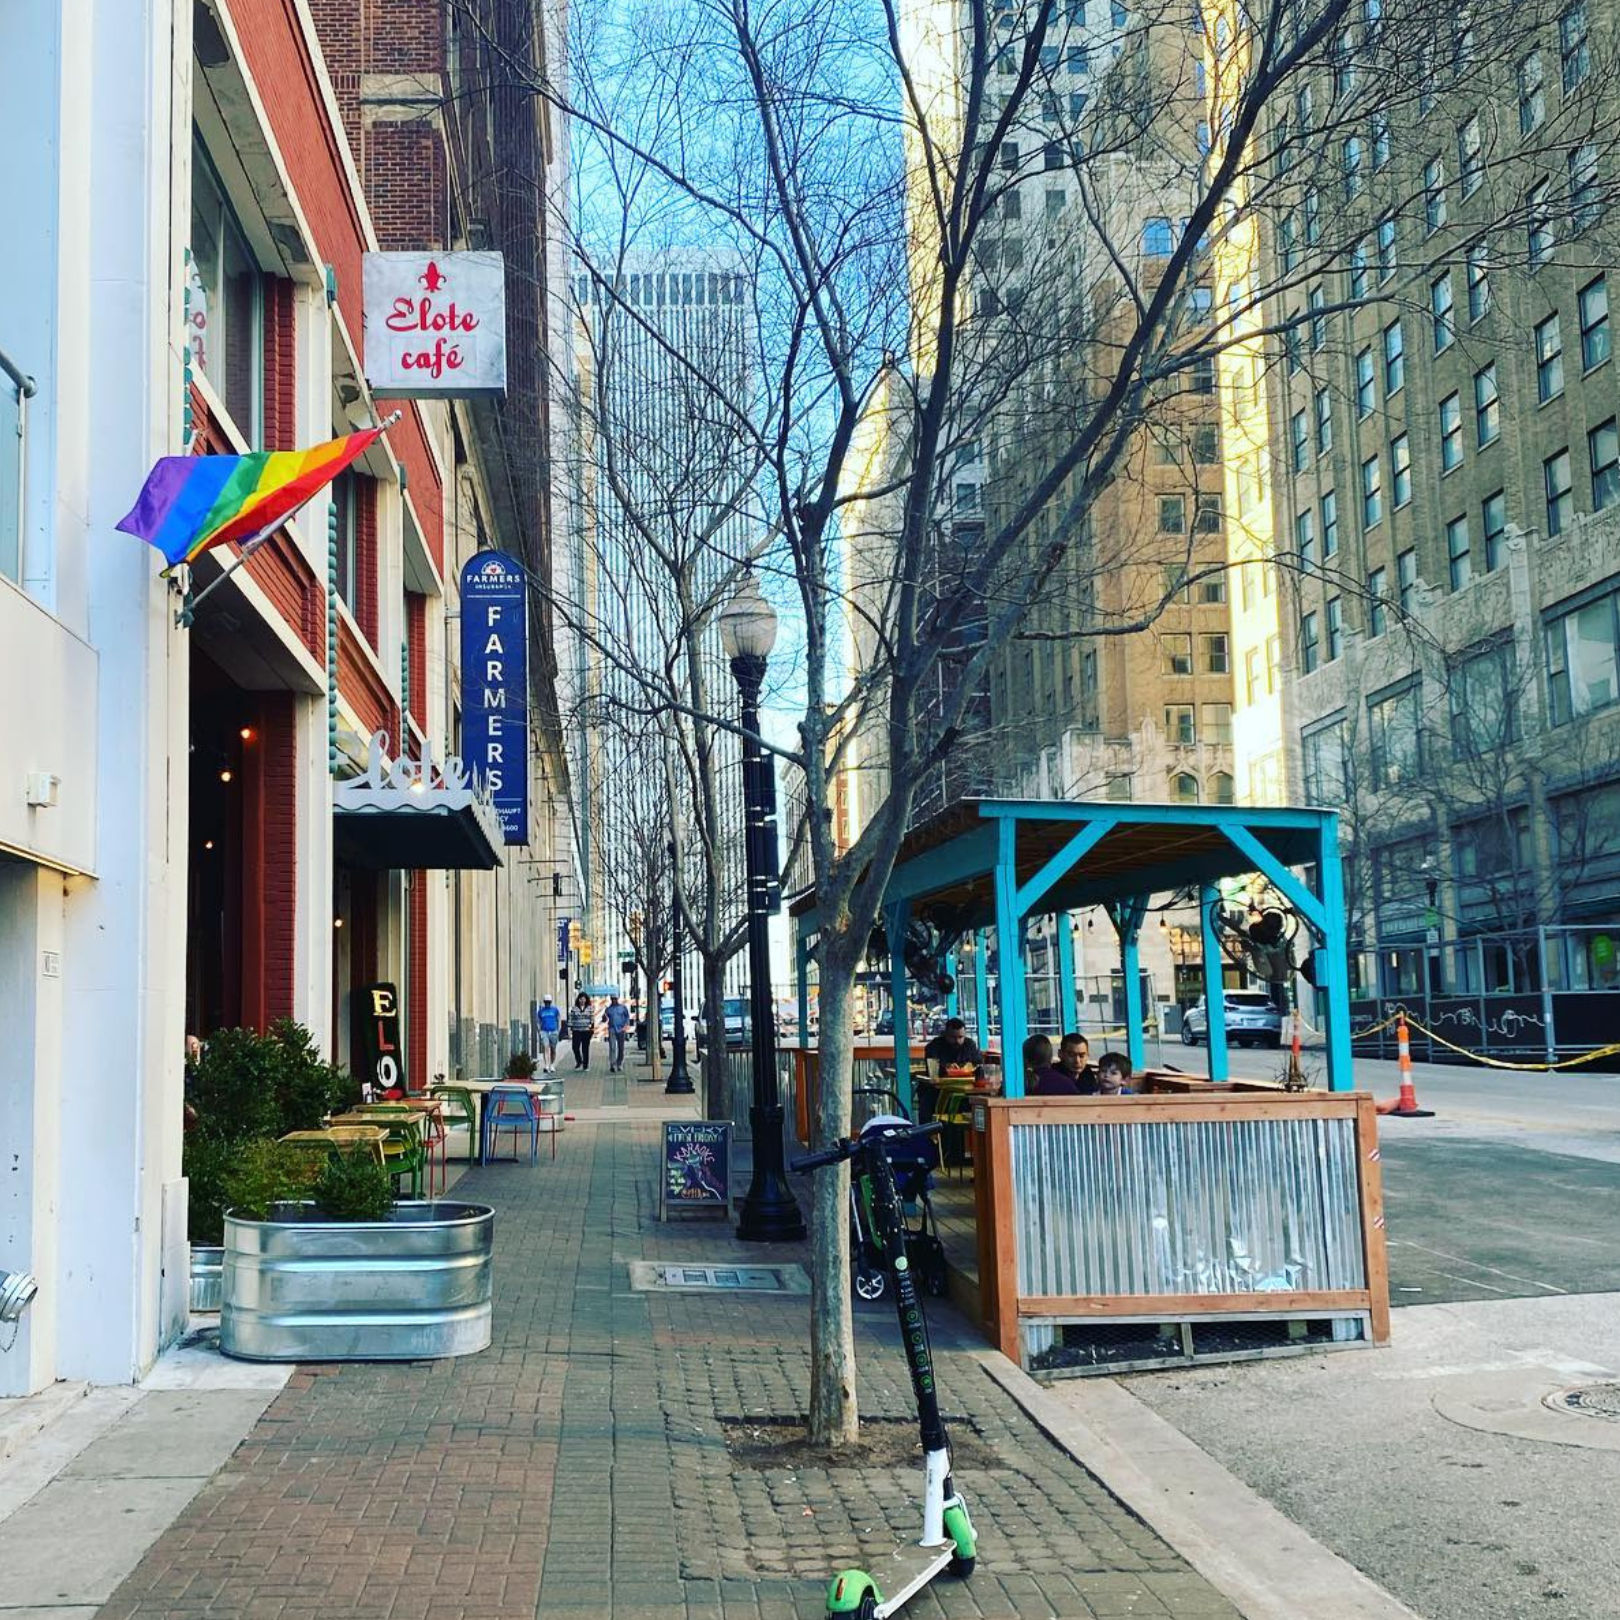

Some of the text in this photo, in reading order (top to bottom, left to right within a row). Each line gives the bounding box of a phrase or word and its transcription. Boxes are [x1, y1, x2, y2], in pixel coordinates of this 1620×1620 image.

[385, 297, 480, 332] Elote
[401, 337, 464, 379] café
[466, 574, 521, 584] FARMERS
[483, 606, 507, 791] FARMERS
[674, 1143, 715, 1165] KARAOKE
